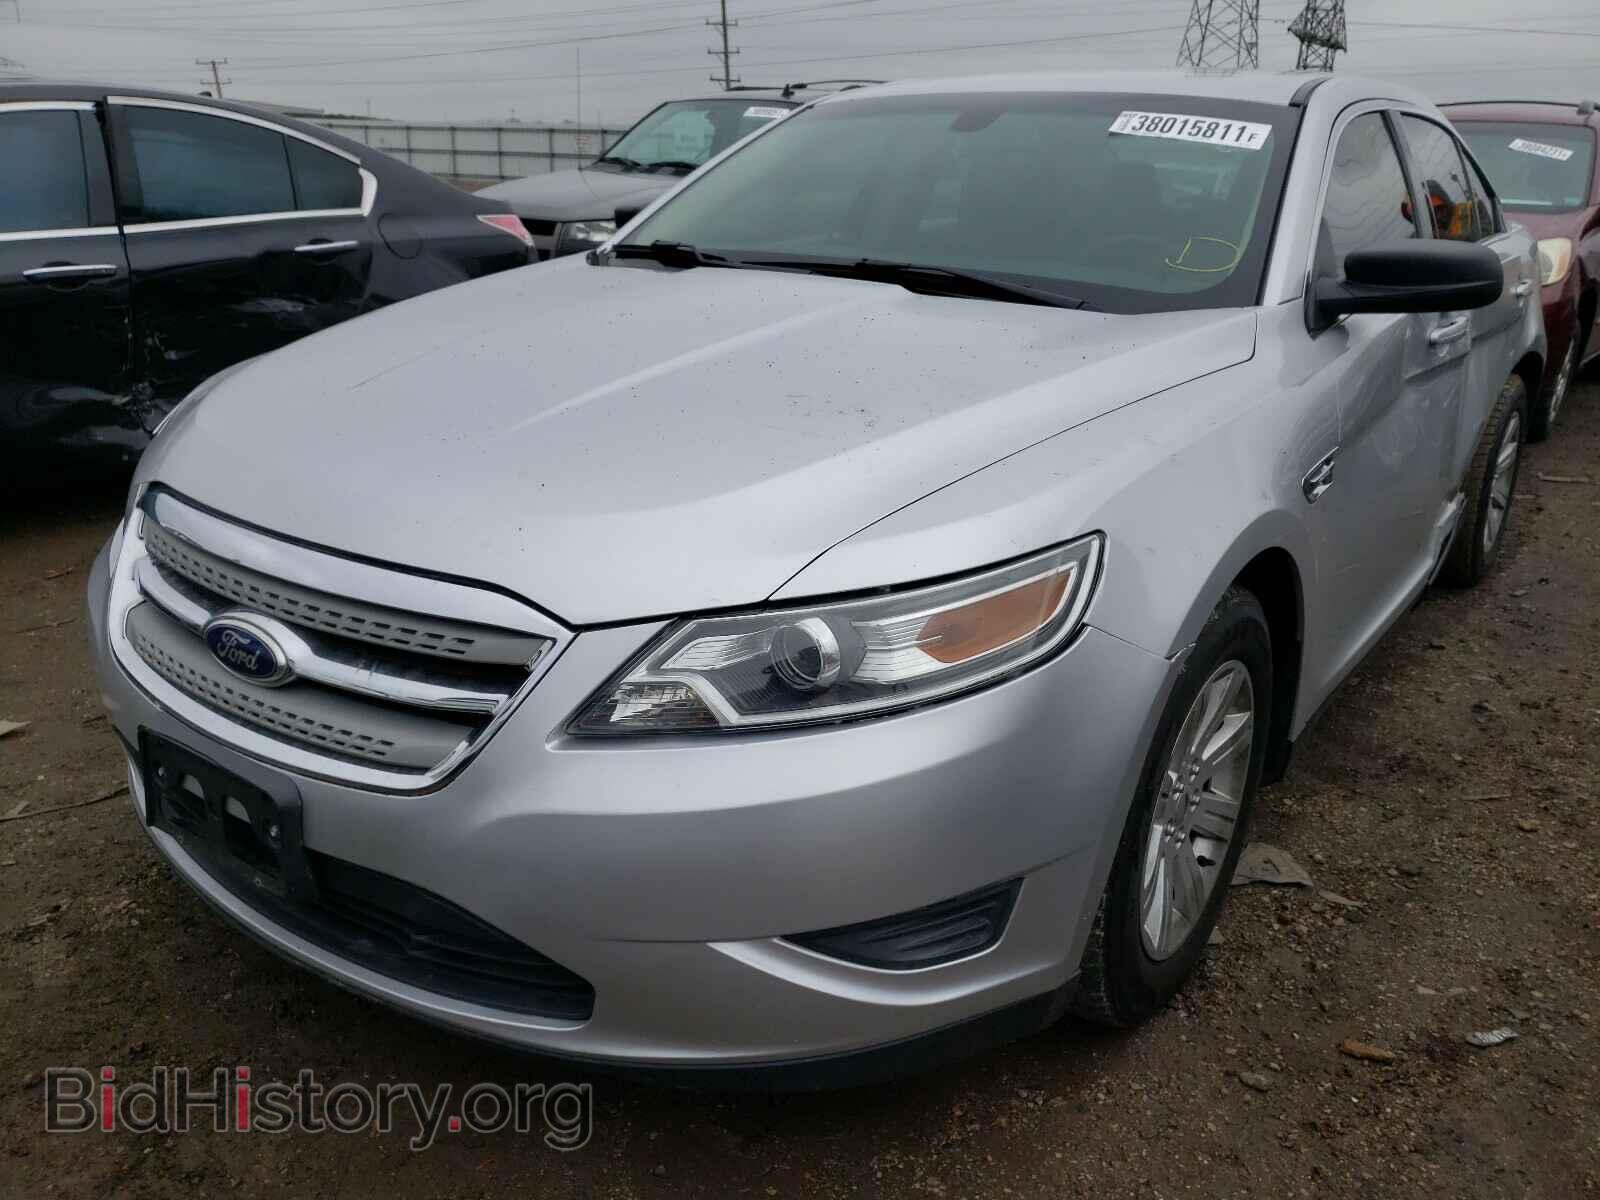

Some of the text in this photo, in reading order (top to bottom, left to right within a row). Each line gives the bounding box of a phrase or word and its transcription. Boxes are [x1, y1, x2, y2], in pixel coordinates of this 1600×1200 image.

[1131, 114, 1248, 143] 38015811
[1247, 132, 1260, 143] F
[216, 629, 261, 671] Ford
